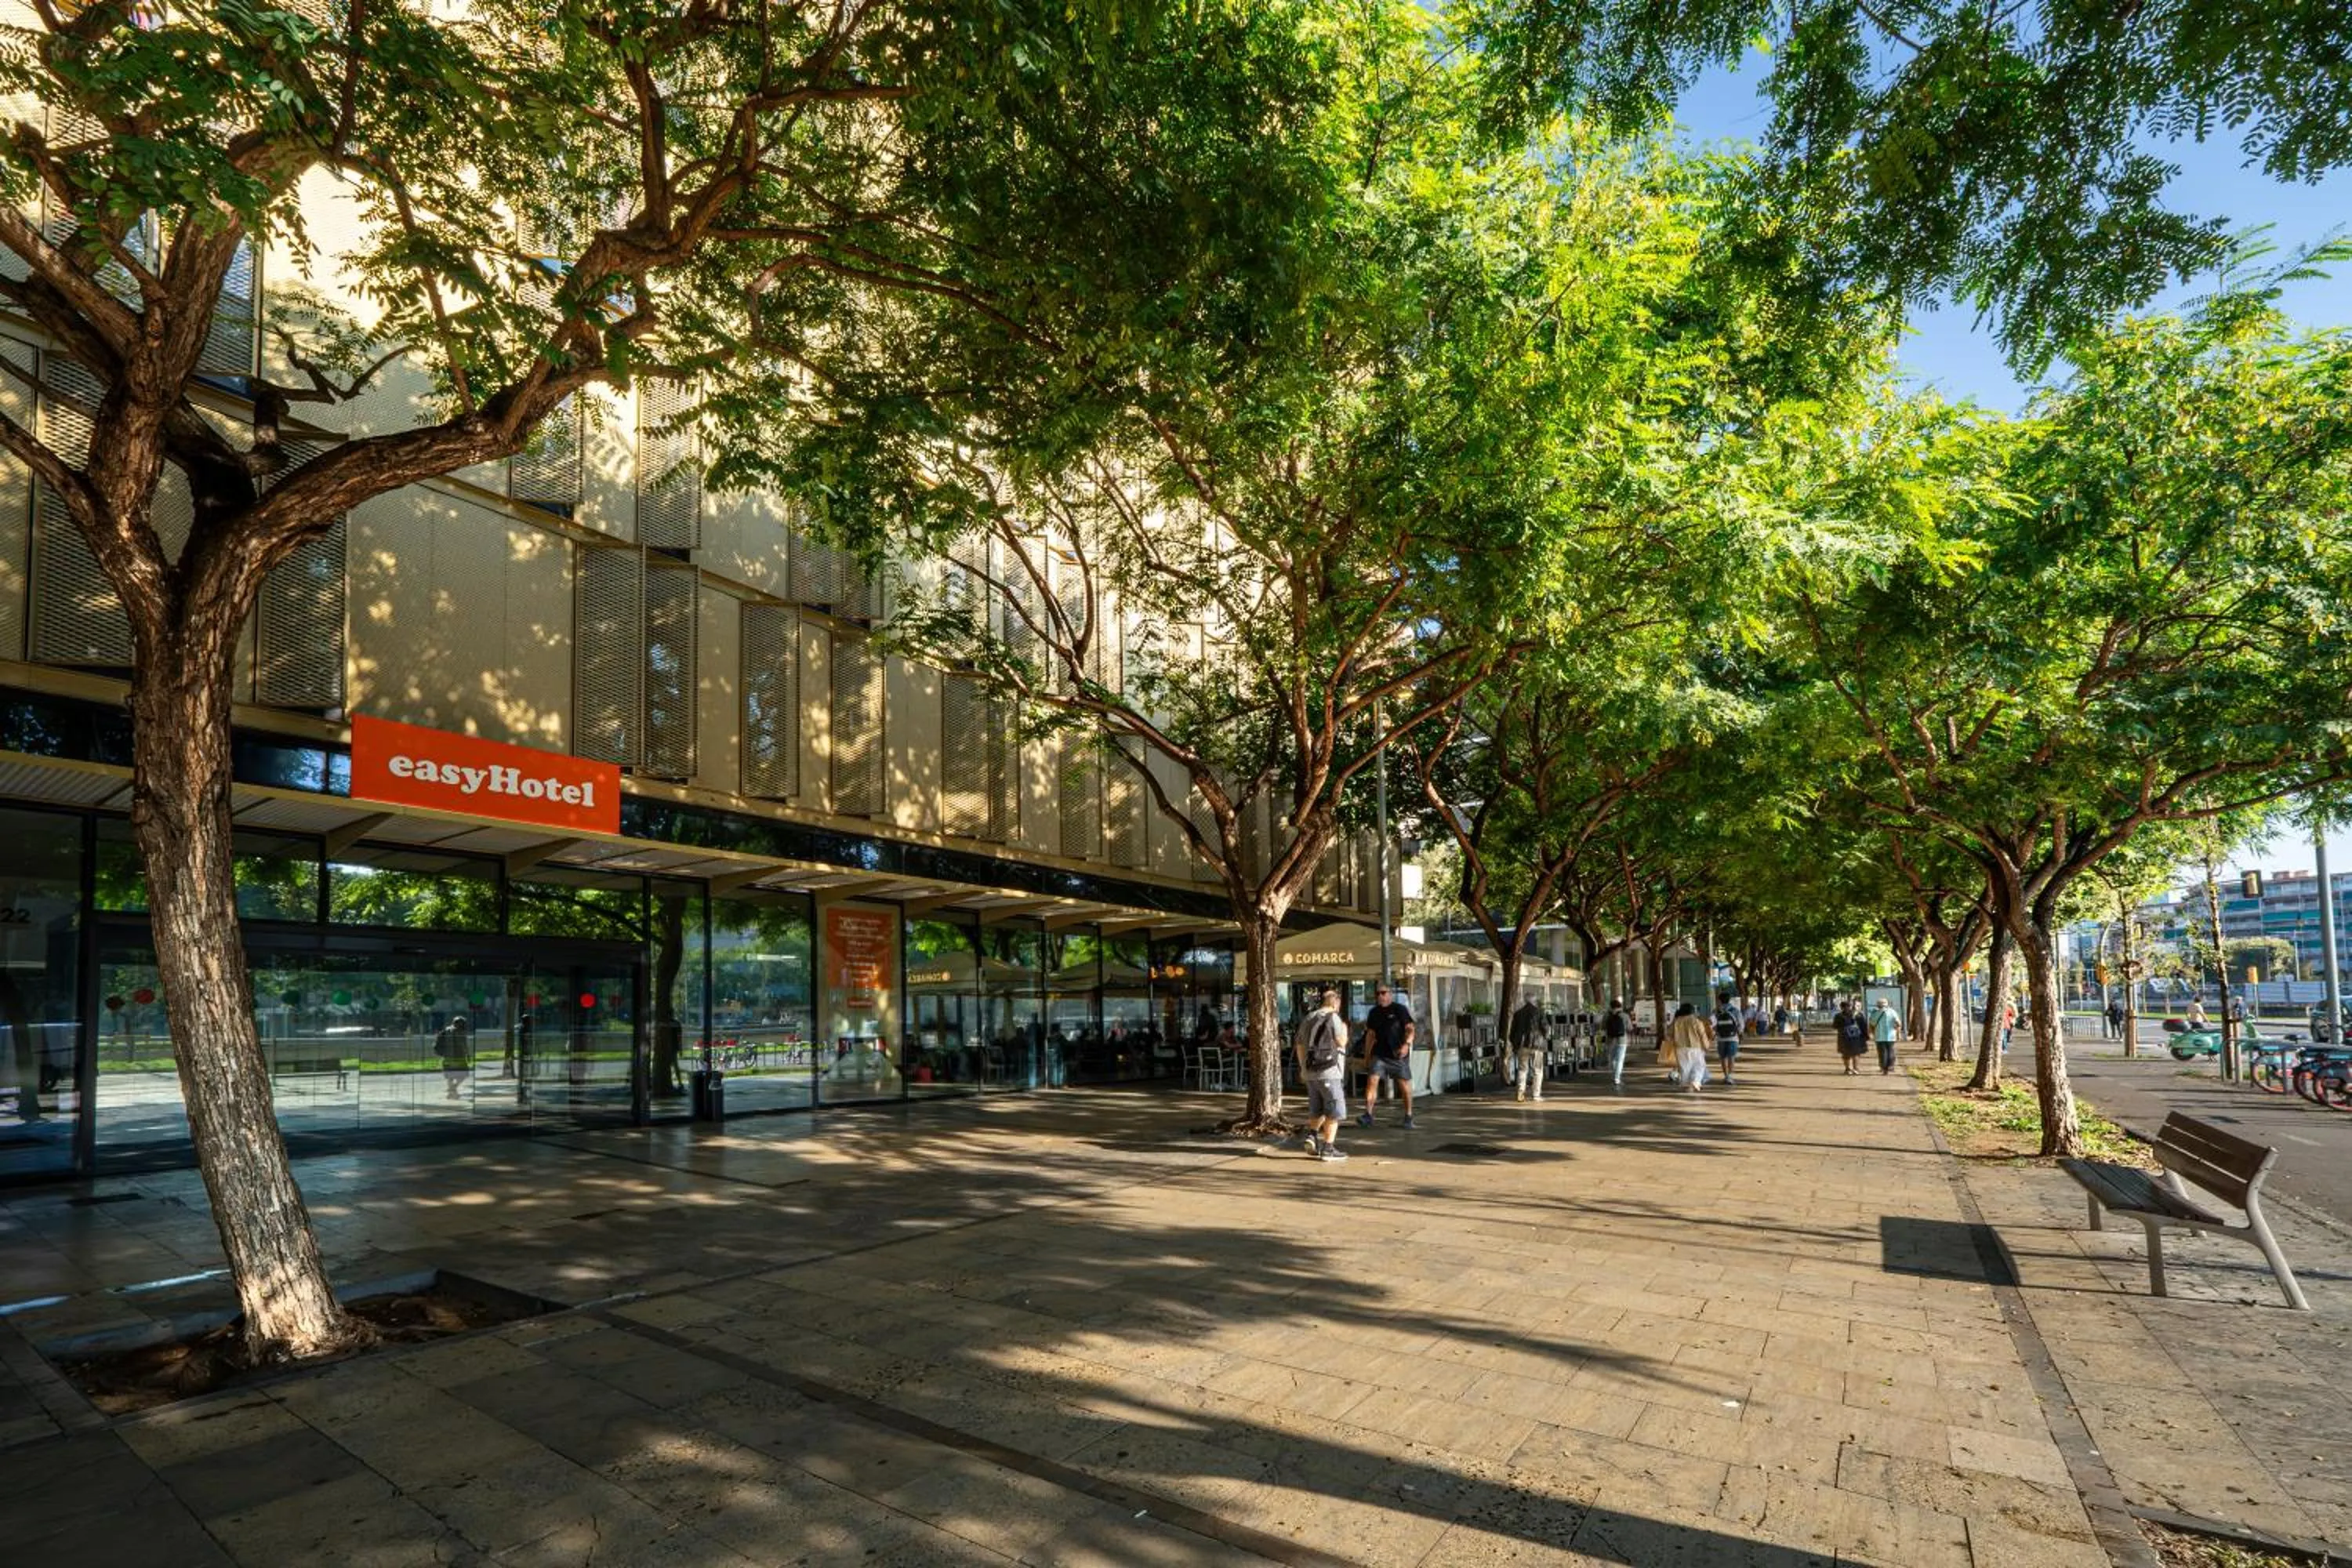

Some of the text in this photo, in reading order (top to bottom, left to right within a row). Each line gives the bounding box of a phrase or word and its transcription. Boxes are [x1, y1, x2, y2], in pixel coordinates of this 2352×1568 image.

[389, 755, 595, 807] easyHotel
[1, 908, 31, 924] 22
[1296, 953, 1355, 964] COMARCA
